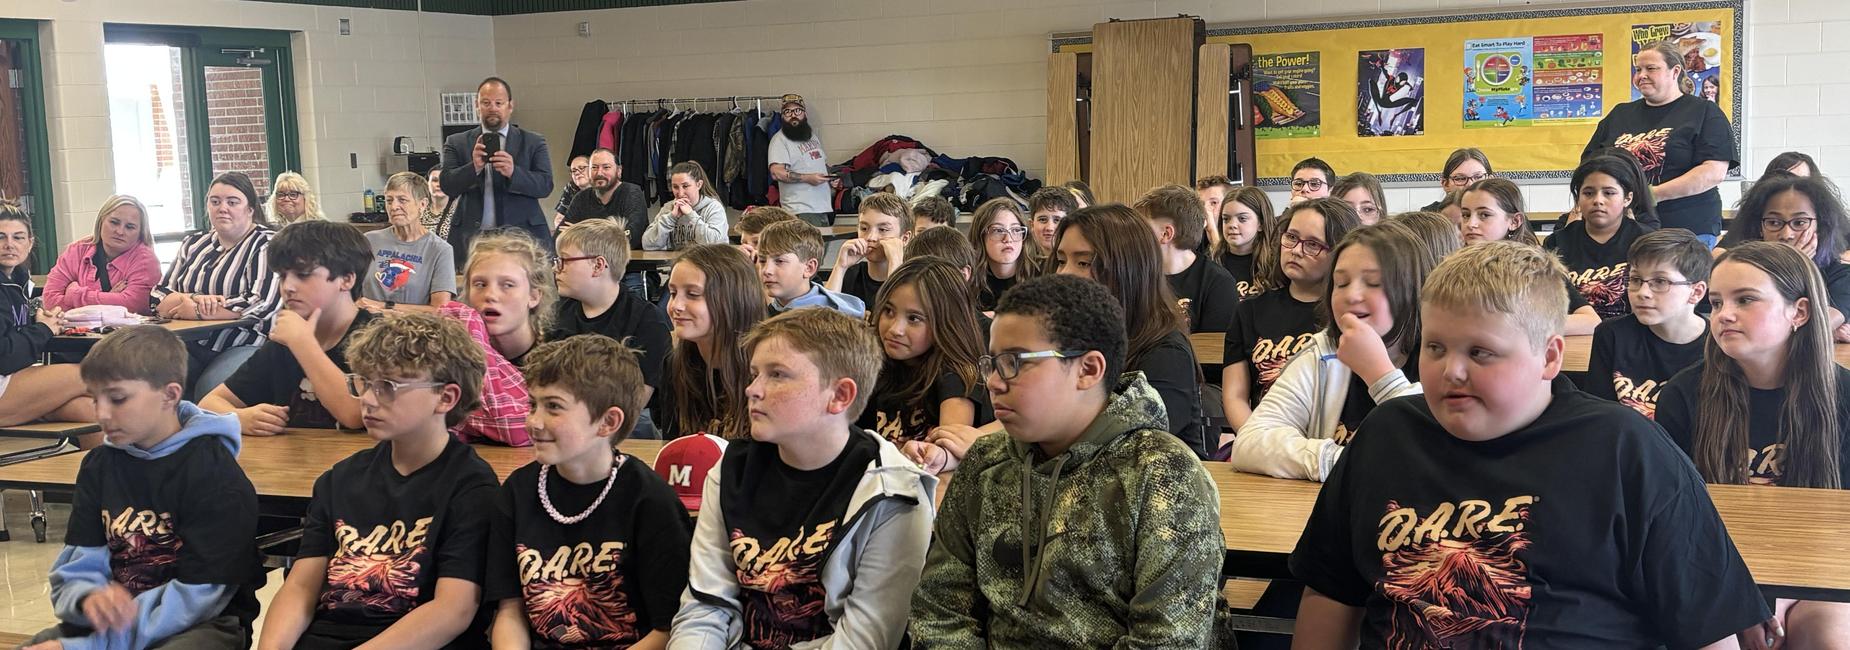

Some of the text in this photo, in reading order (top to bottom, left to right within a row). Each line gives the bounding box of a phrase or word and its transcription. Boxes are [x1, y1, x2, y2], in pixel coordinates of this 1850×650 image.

[1633, 26, 1670, 40] Who Grew
[1258, 53, 1310, 68] the Power!
[668, 464, 693, 487] M
